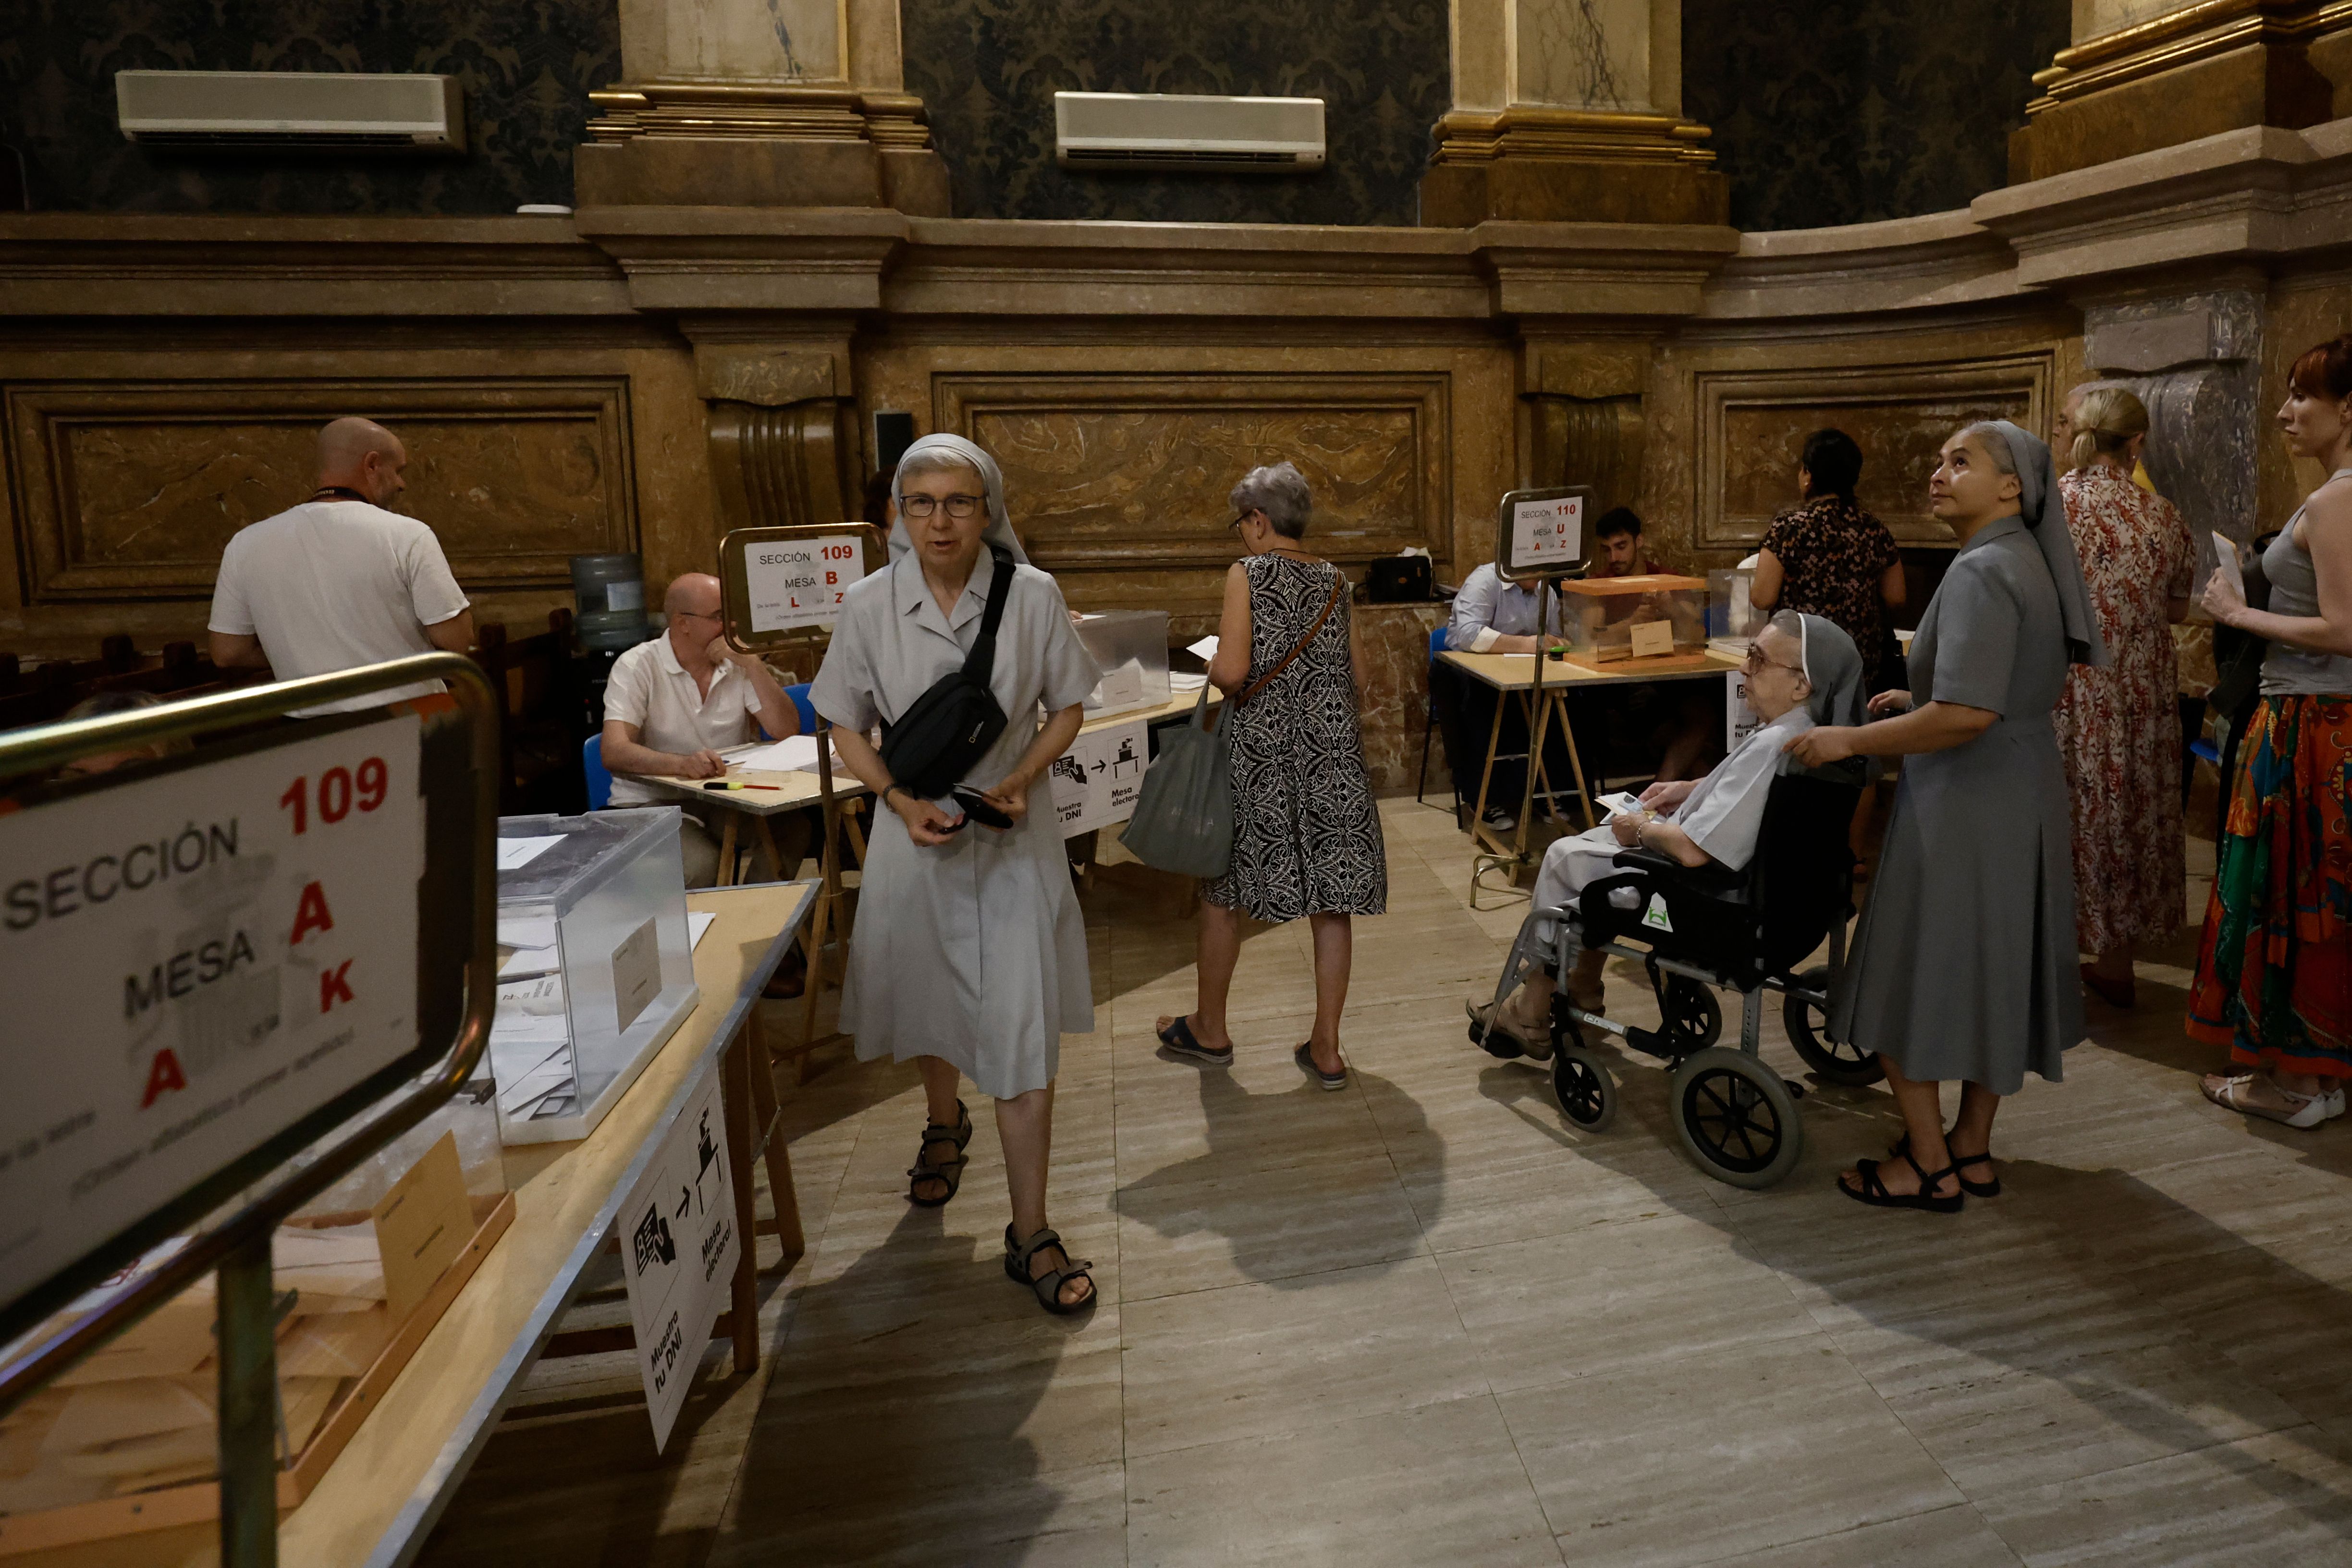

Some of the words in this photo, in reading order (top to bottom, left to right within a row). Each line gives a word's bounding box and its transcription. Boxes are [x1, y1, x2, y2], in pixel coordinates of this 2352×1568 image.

[1521, 509, 1551, 519] SECCIÓN
[1557, 504, 1576, 515] 110
[1533, 528, 1552, 537] MESA
[1557, 524, 1565, 534] U
[760, 551, 810, 564] SECCIÓN
[821, 545, 853, 560] 109
[1534, 542, 1541, 551] A
[1560, 540, 1567, 548] Z
[785, 577, 817, 588] MESA
[825, 571, 838, 585] B
[791, 597, 800, 608] L
[834, 592, 844, 603] Z
[1112, 787, 1132, 798] Mesa
[1112, 794, 1140, 807] electora
[1066, 808, 1081, 821] DNI
[4, 817, 239, 932] SECCIÓN
[281, 756, 388, 835] 109
[124, 930, 256, 1019] MESA
[290, 881, 334, 945] A
[141, 1047, 187, 1110] A
[321, 957, 355, 1014] K
[702, 1219, 721, 1265] Mesa
[706, 1218, 731, 1282] electoral
[651, 1310, 678, 1372] Muestra
[655, 1369, 666, 1394] tu
[666, 1326, 682, 1371] DNI
